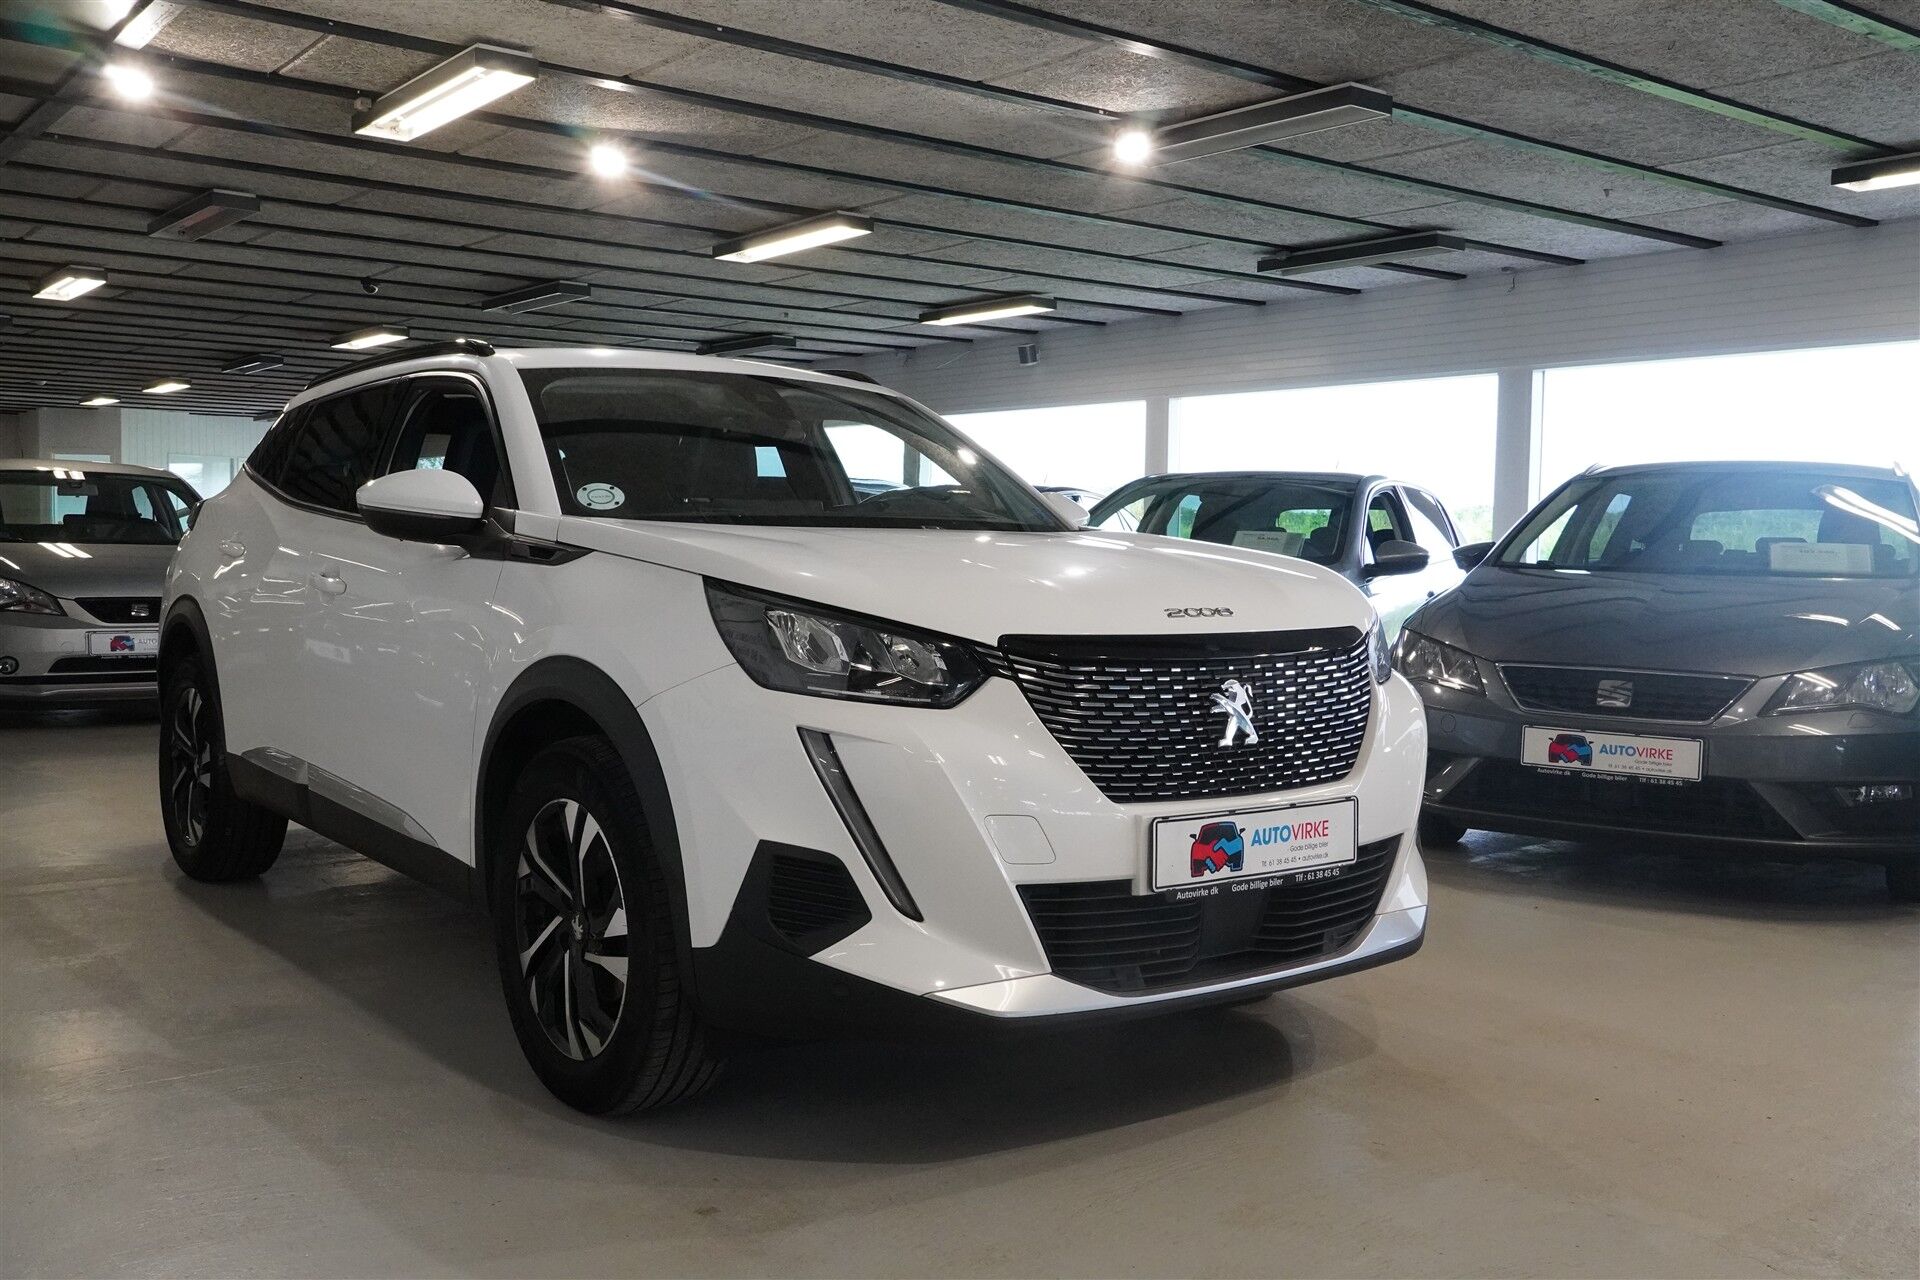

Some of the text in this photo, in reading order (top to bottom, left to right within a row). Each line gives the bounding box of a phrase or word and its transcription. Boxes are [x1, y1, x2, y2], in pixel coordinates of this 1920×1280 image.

[1163, 607, 1234, 618] 2008
[1599, 743, 1673, 761] AUTOVIRKE
[1250, 820, 1329, 846] AUTOVIRKE
[1307, 872, 1315, 881] 61
[1315, 870, 1324, 879] 38
[1324, 869, 1331, 878] 45
[1332, 867, 1340, 876] 45
[1231, 878, 1284, 892] Gode billige biler
[1176, 886, 1219, 900] Autovirke dk
